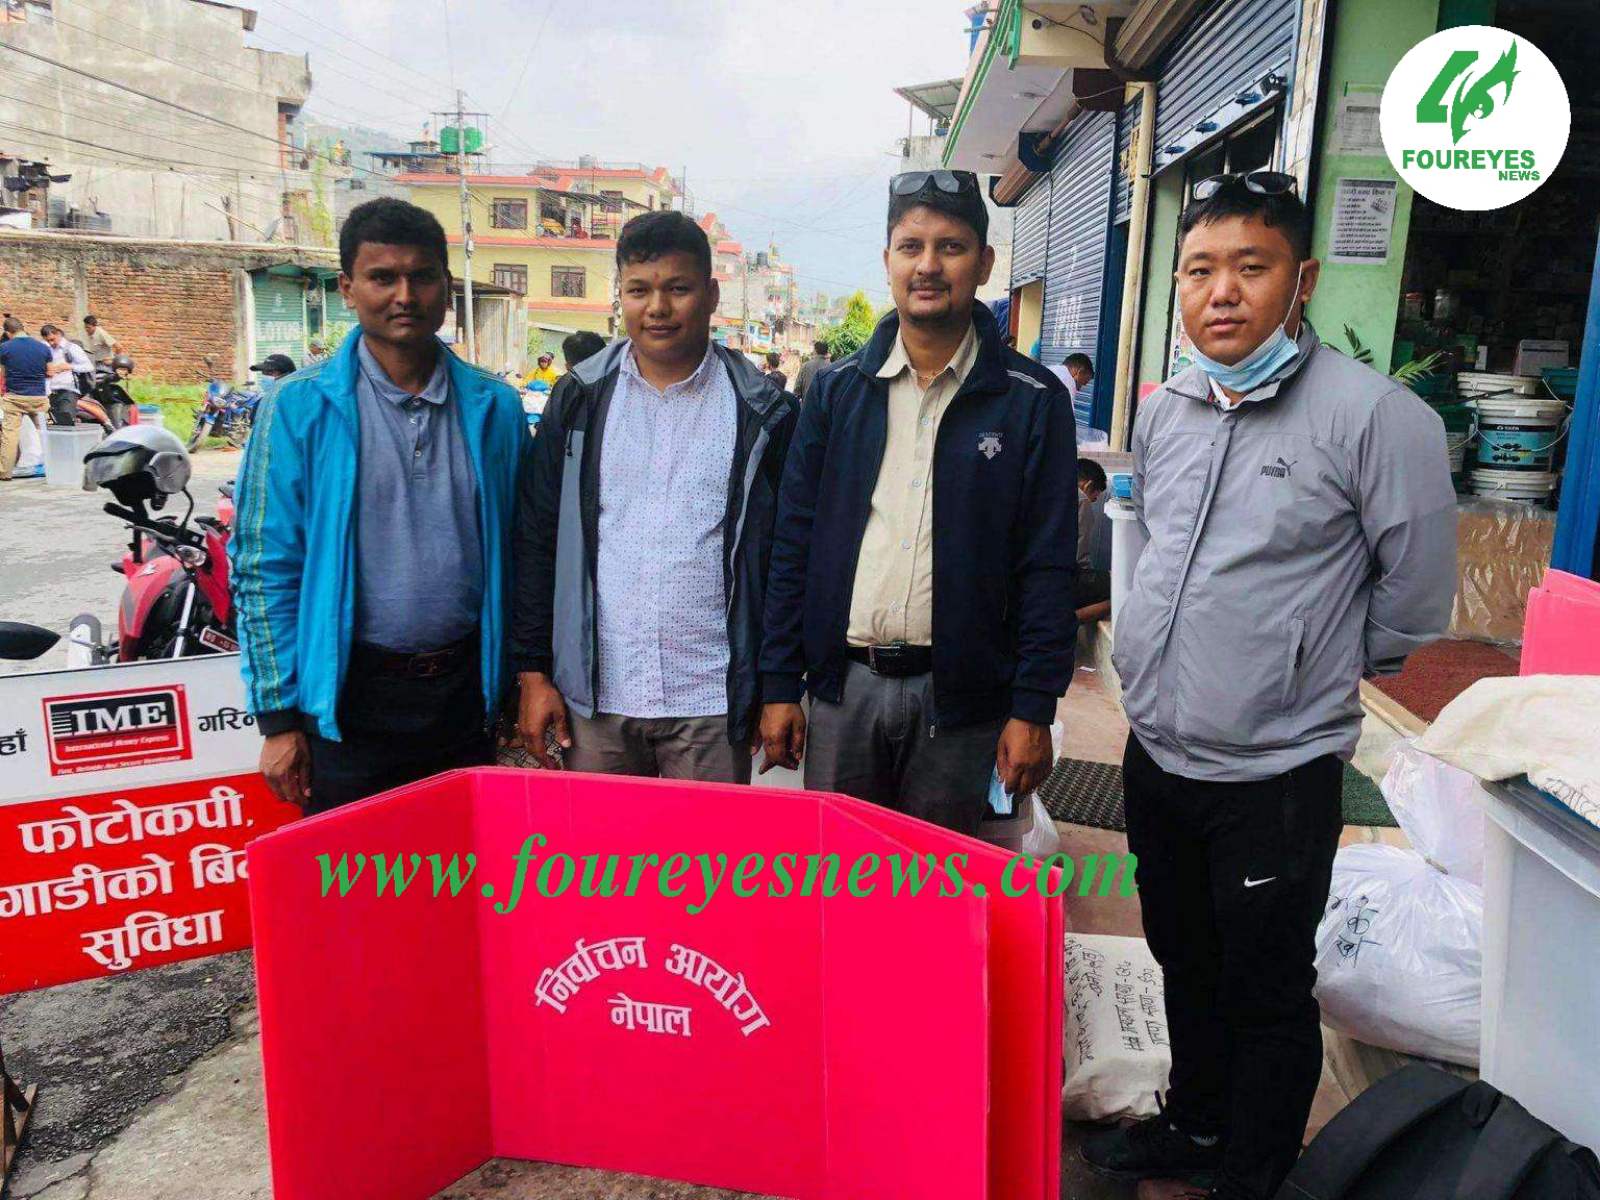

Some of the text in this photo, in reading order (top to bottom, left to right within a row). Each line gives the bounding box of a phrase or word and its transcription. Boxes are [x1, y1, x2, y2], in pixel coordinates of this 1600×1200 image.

[71, 701, 168, 735] IME
[0, 853, 175, 918] गाडीको
[80, 909, 225, 970] सुविधा
[534, 936, 771, 1037] निर्वाचन आयोग
[607, 992, 692, 1037] नेपाल
